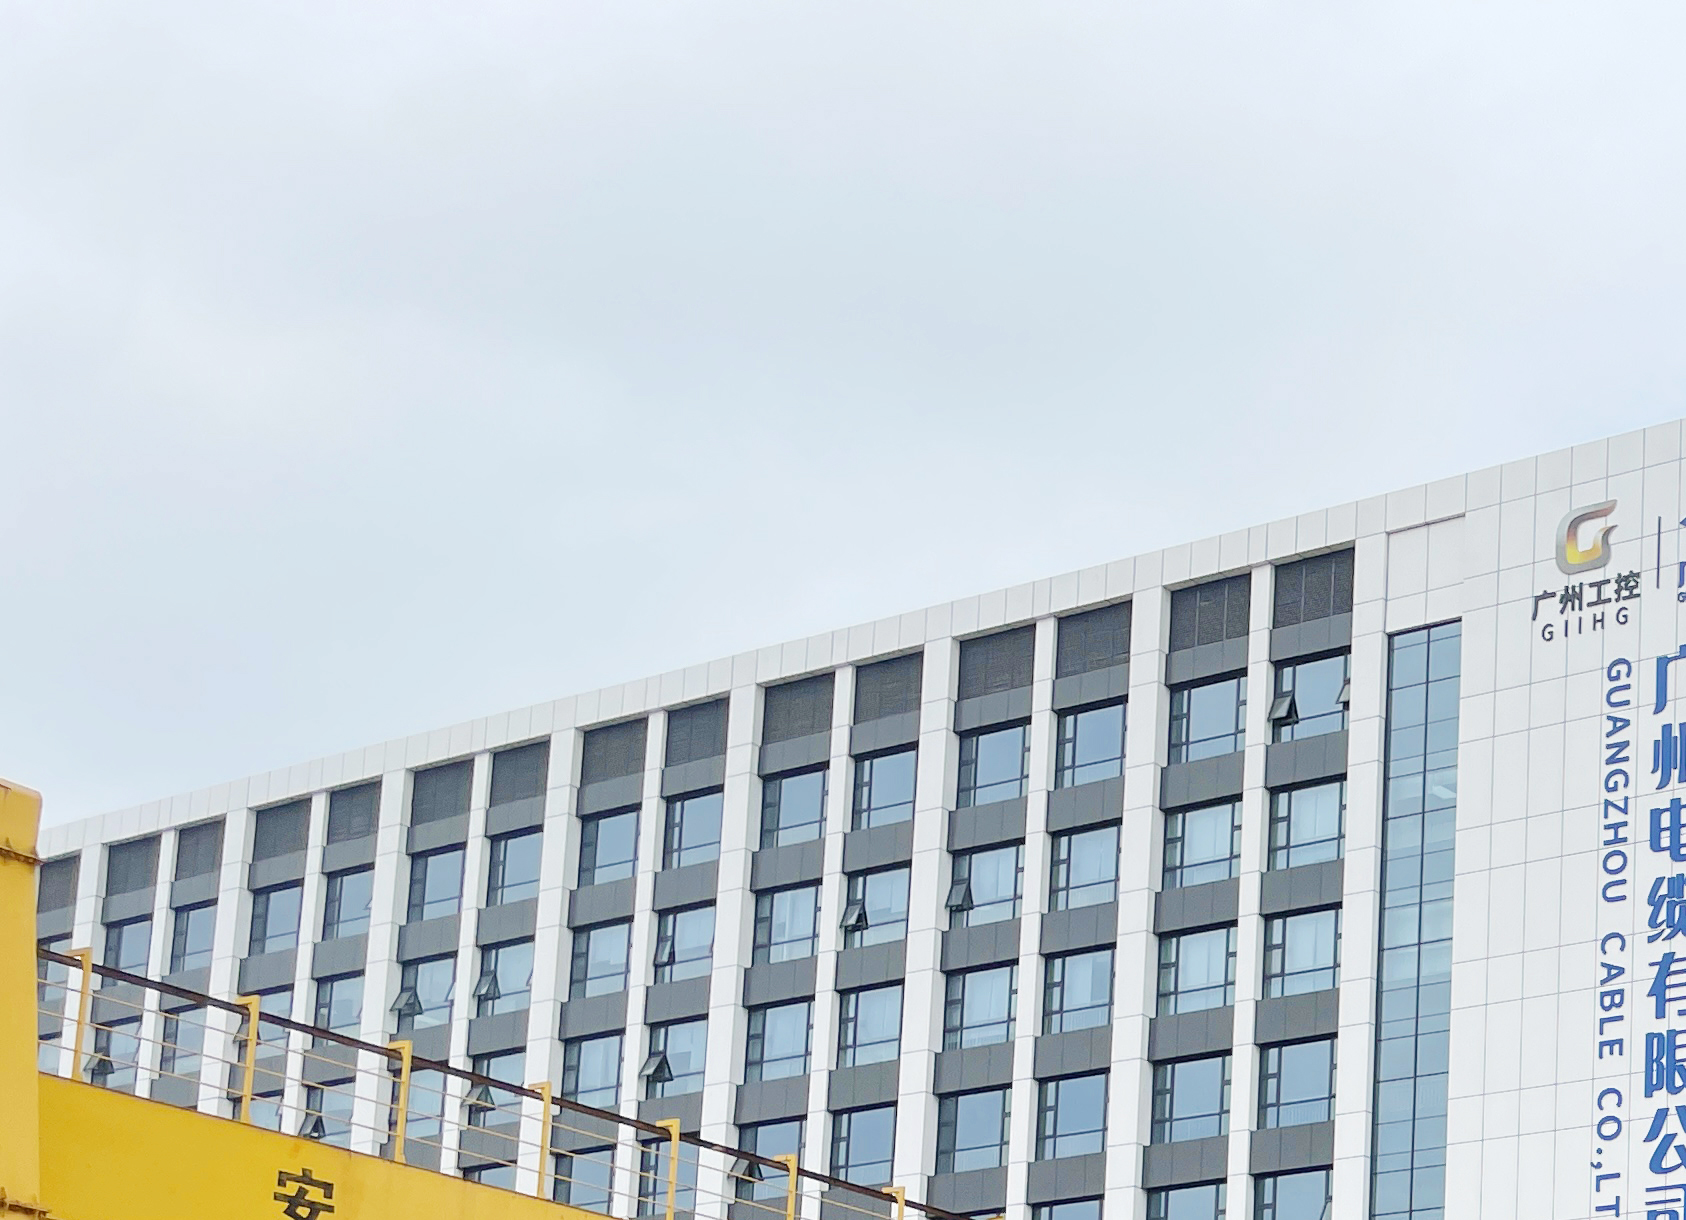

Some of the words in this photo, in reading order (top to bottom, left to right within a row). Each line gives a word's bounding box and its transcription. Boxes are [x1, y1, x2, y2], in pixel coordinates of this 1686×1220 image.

[1532, 570, 1641, 621] 广州工控
[1541, 606, 1629, 641] GIIHG
[1601, 657, 1632, 903] GUANGZHOU
[1598, 932, 1627, 1060] CABLE
